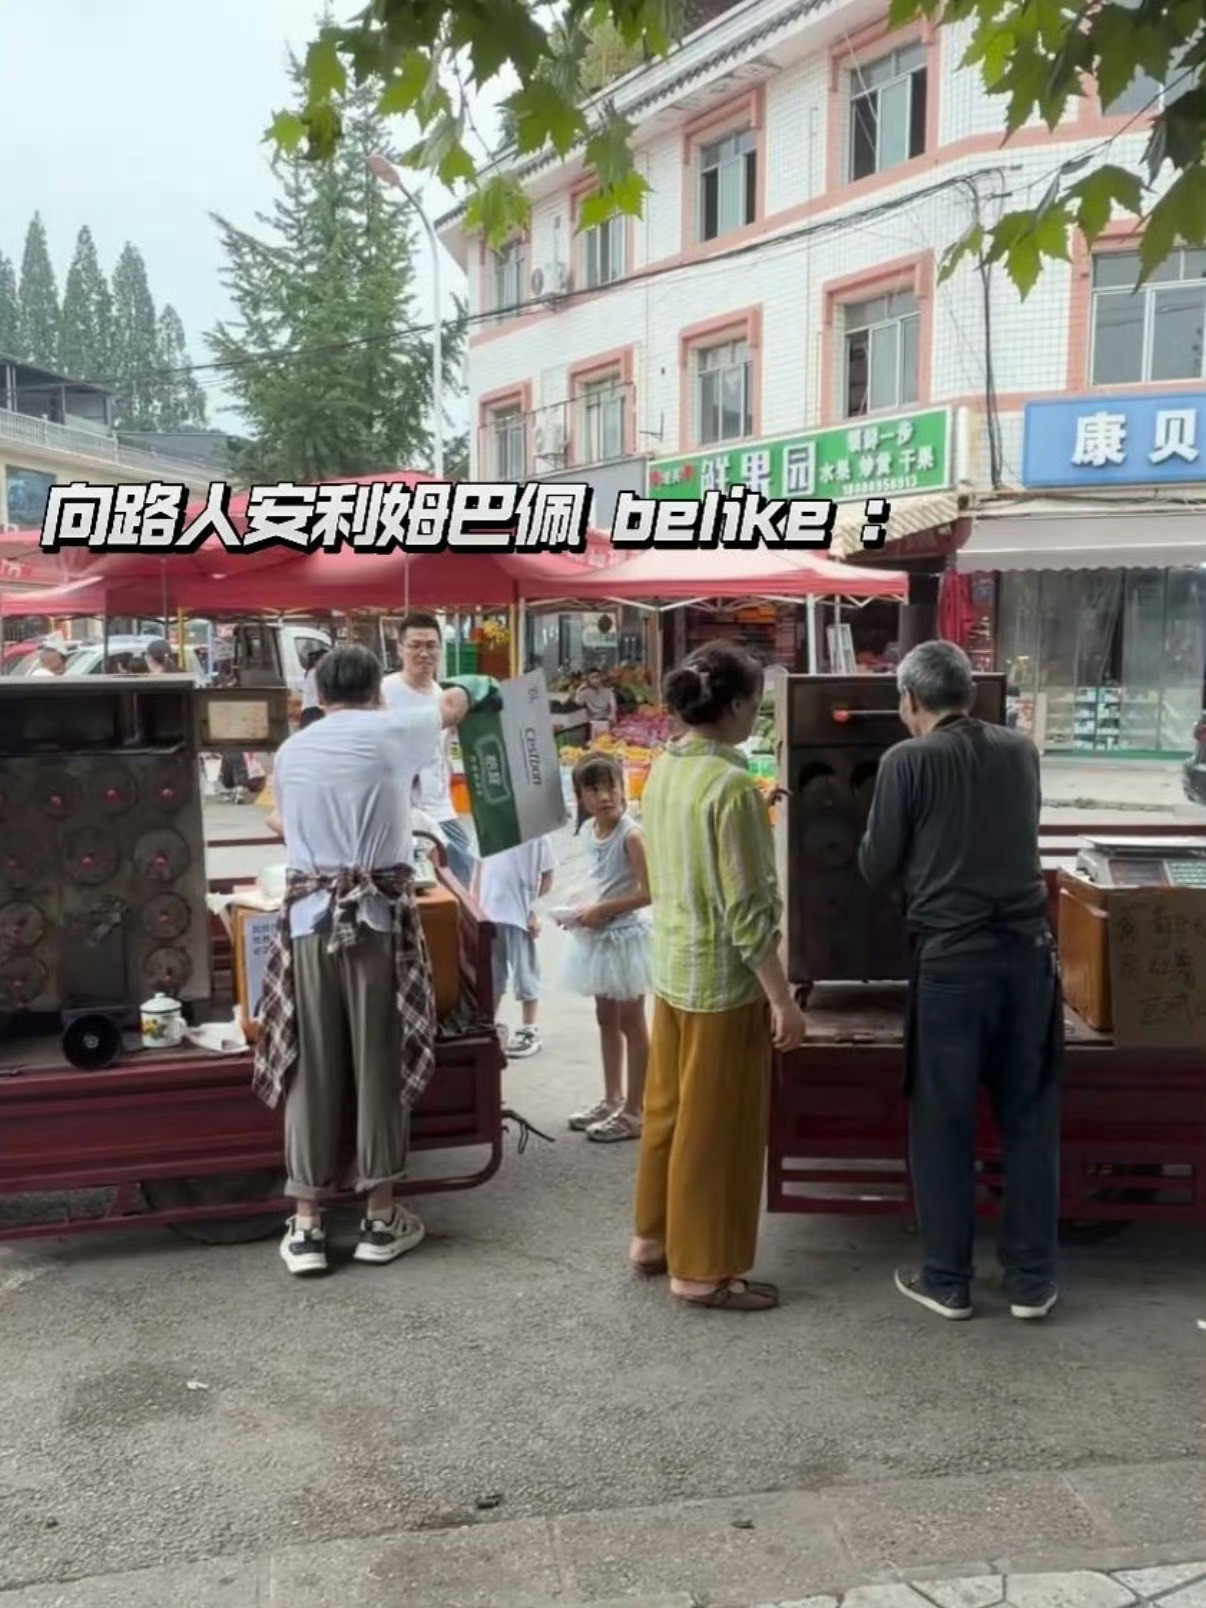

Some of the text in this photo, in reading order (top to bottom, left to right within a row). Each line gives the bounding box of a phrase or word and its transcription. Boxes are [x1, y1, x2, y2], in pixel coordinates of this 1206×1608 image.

[1071, 410, 1200, 468] 康贝
[701, 440, 816, 502] 鲜果园
[818, 459, 851, 485] 水果
